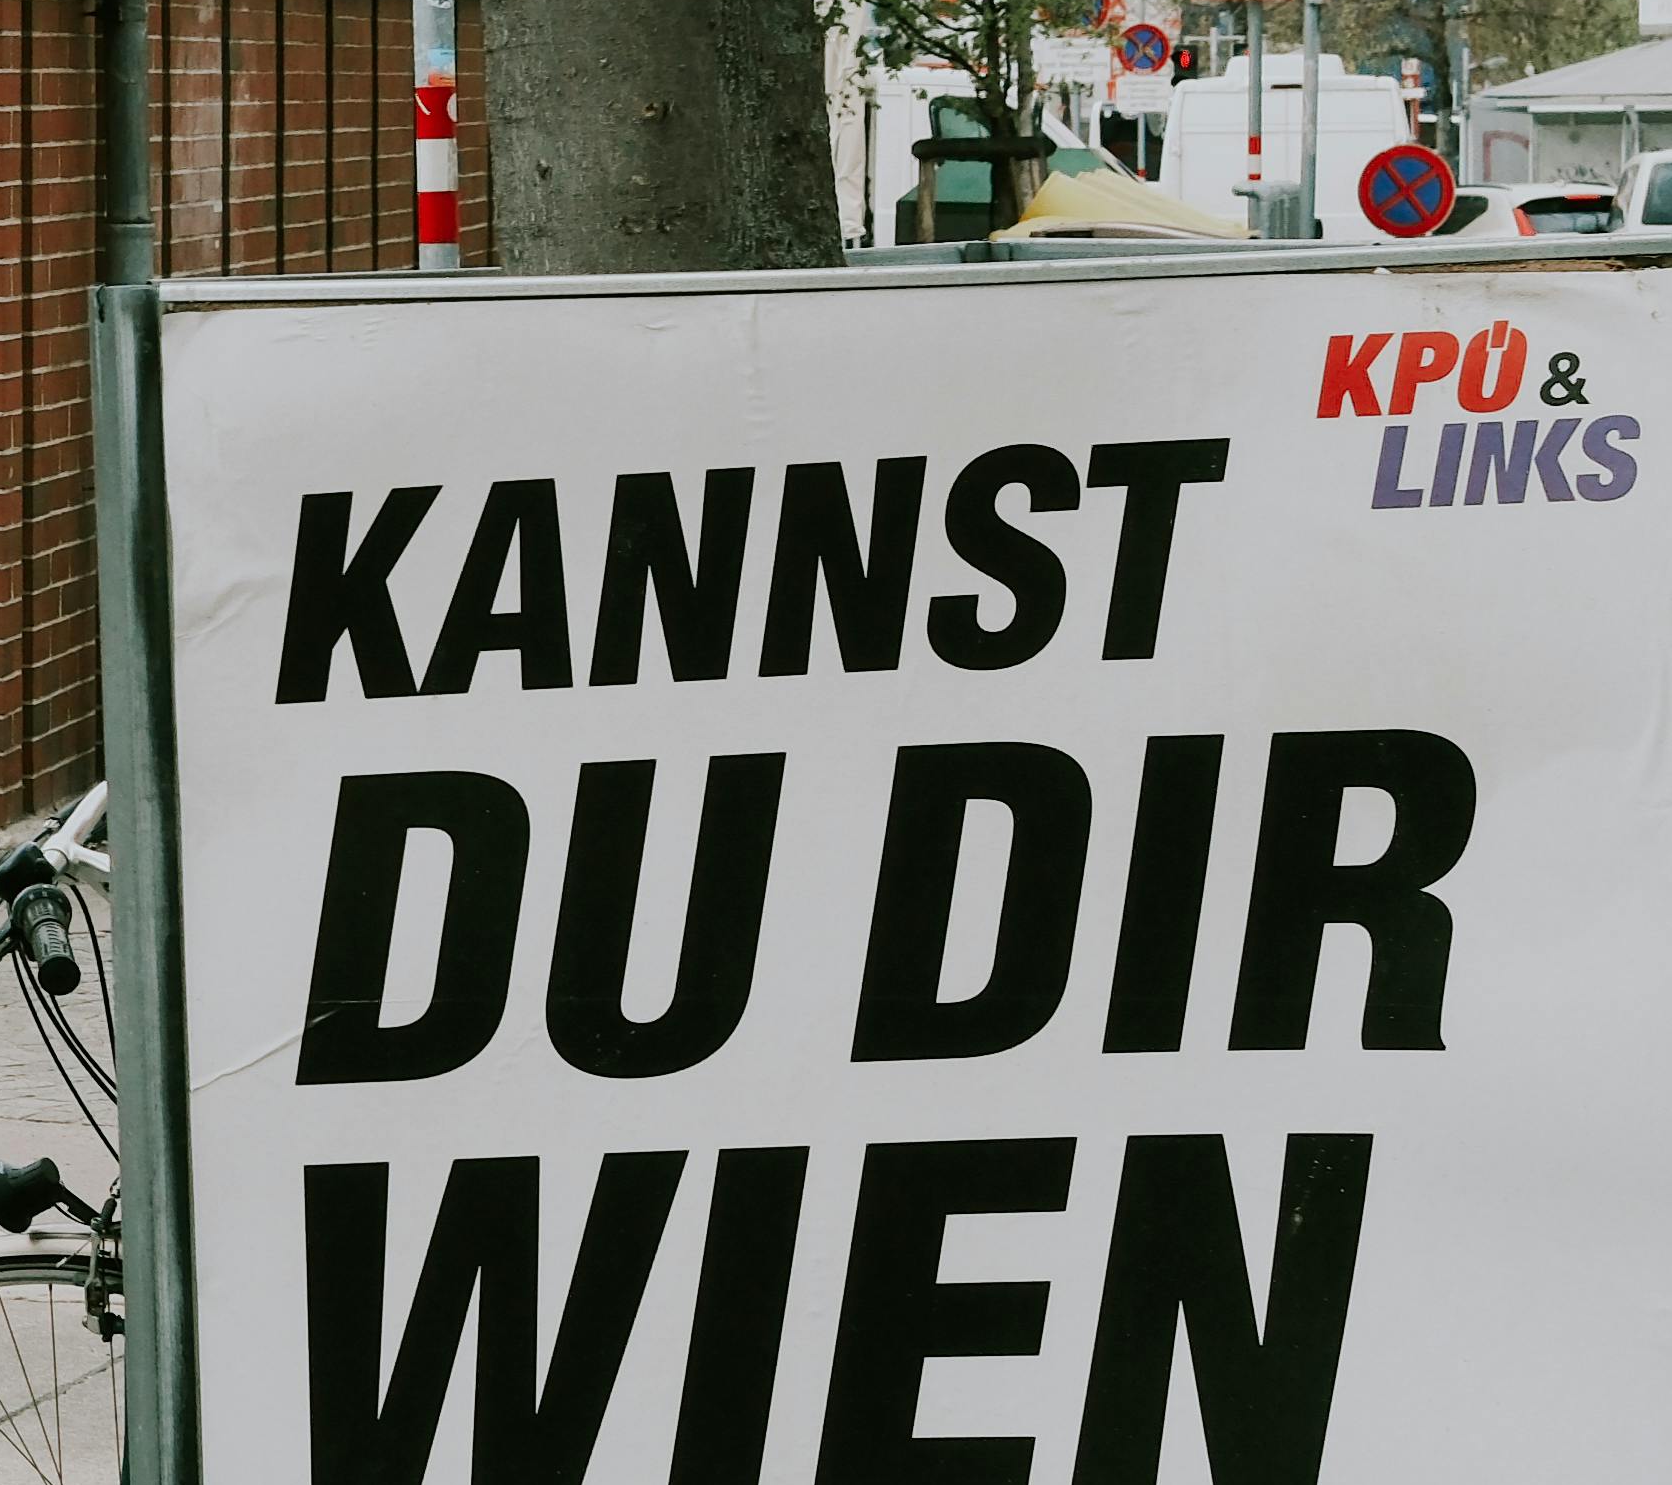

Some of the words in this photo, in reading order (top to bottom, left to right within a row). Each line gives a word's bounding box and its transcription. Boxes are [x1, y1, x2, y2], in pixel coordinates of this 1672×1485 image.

[1316, 319, 1529, 421] KPÖ
[1540, 350, 1592, 407] &
[1370, 412, 1643, 511] LINKS
[273, 437, 1232, 707] KANNST
[293, 751, 788, 1089] DU
[849, 727, 1480, 1065] DIR
